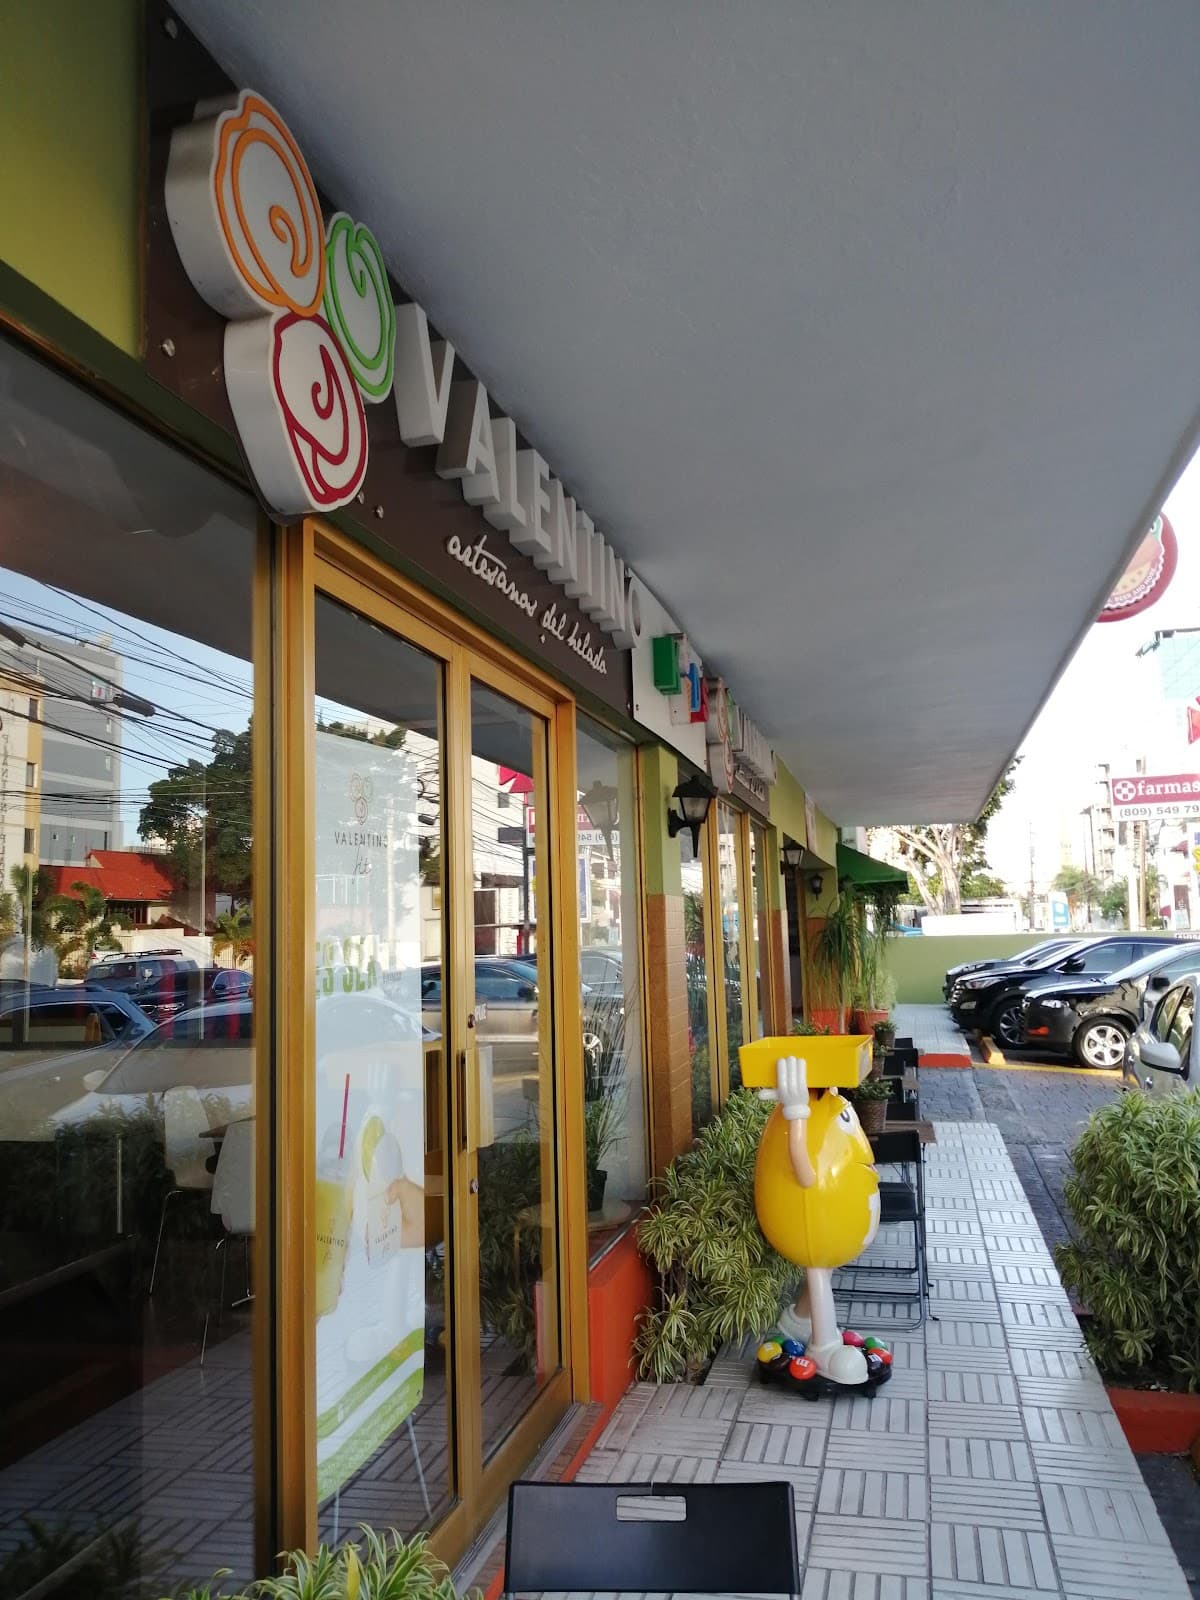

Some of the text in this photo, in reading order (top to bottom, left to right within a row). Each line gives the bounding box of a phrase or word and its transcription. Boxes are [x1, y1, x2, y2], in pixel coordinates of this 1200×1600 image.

[393, 302, 642, 650] VALENTINO
[447, 534, 607, 675] artesanos del helado
[1119, 807, 1152, 818] (809)
[1156, 806, 1179, 815] 549
